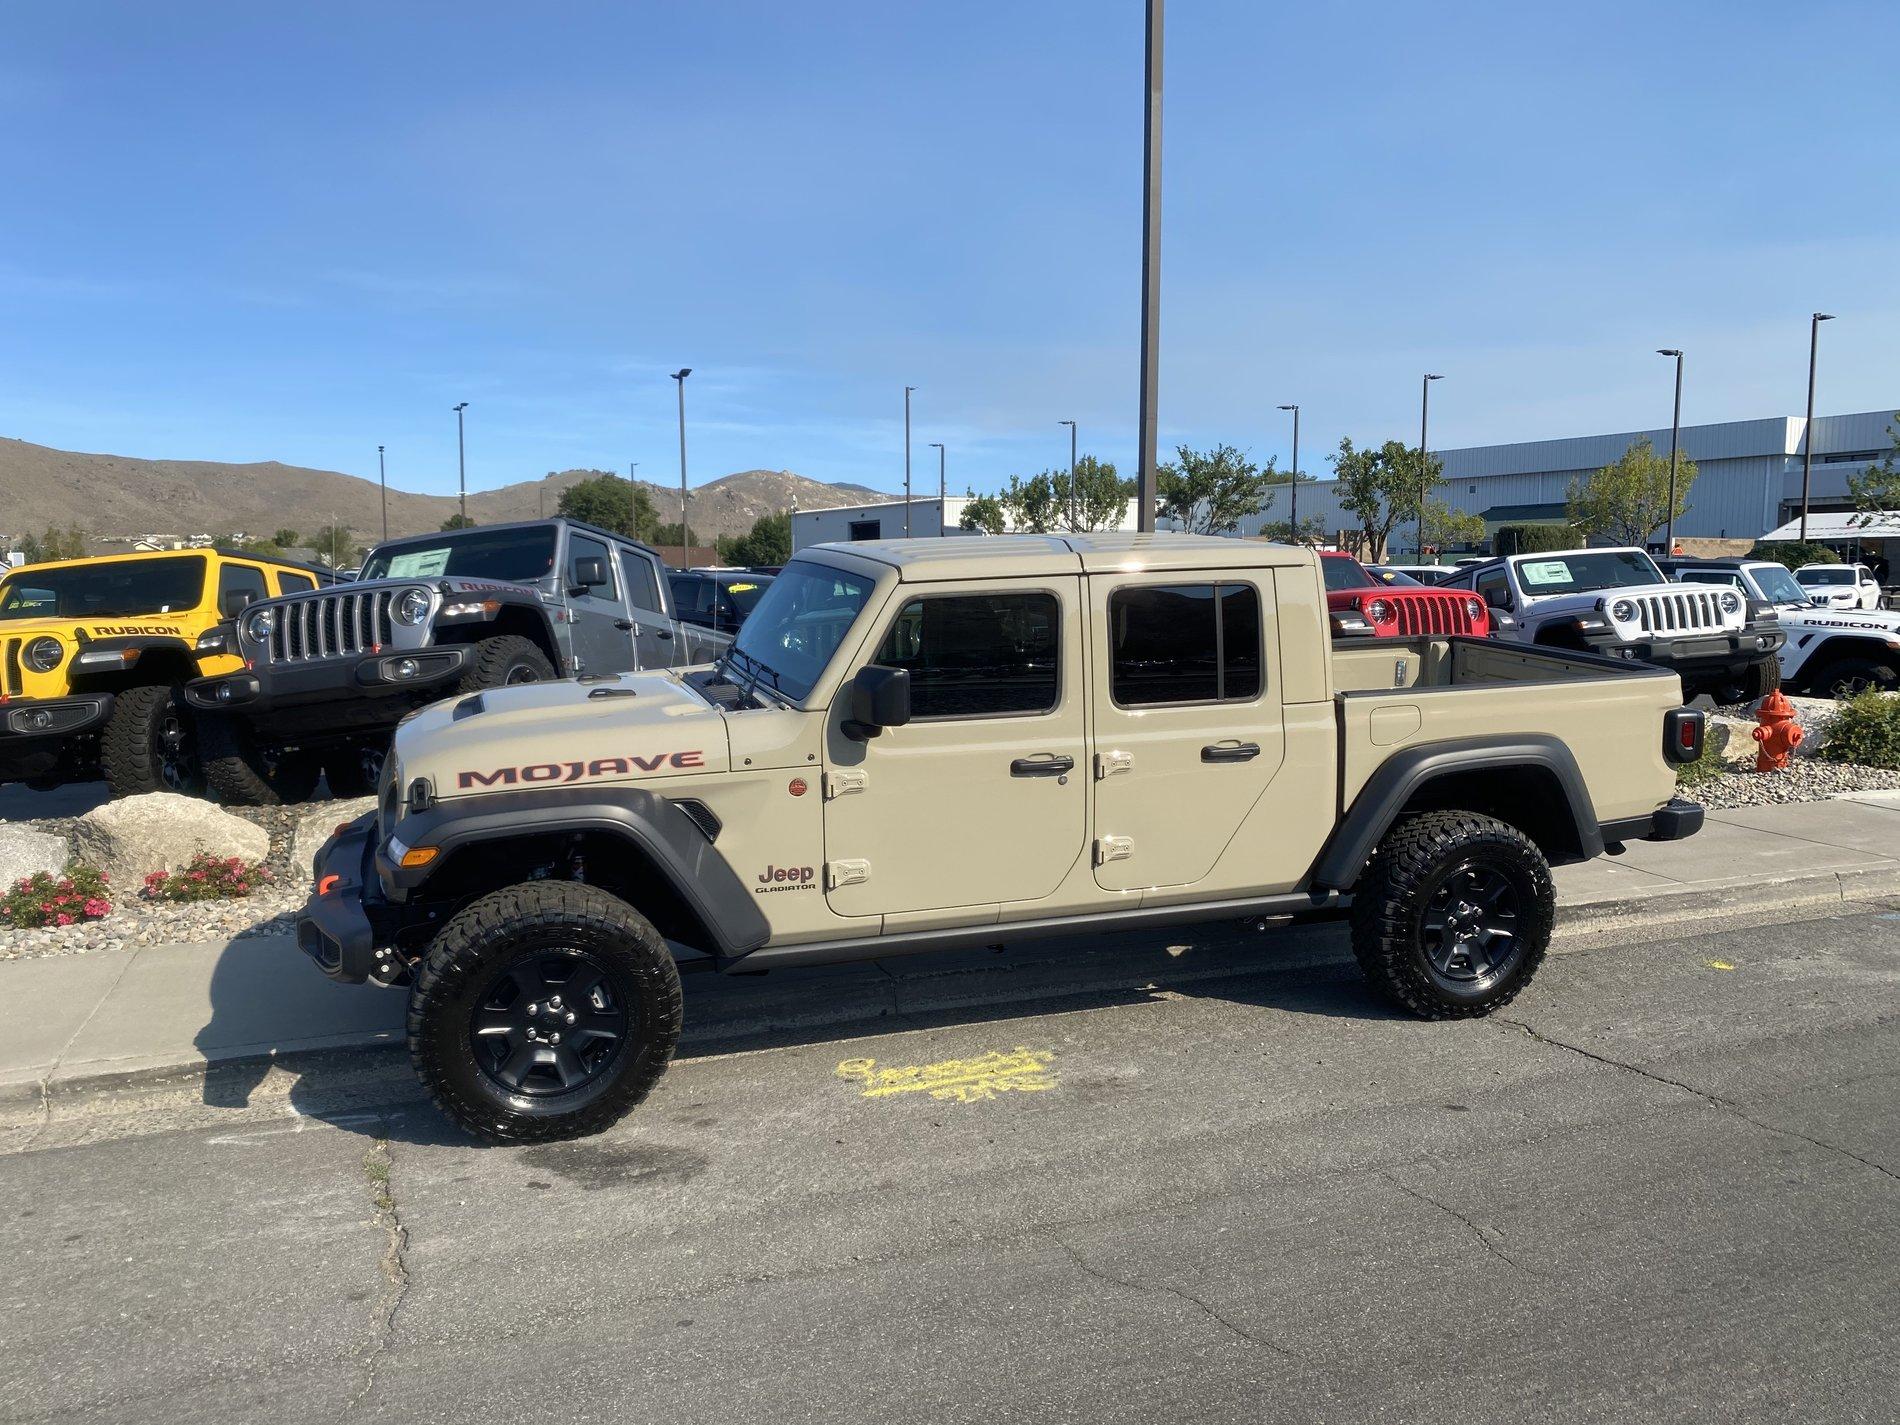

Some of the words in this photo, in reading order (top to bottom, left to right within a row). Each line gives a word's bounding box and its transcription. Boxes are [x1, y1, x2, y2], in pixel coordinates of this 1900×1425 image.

[458, 582, 535, 596] RUBICON
[1803, 619, 1888, 630] RUBICON
[93, 626, 181, 636] RUBICON
[457, 750, 705, 790] MOJAVE
[759, 864, 814, 884] Jeep
[755, 883, 816, 894] GLADIATOR
